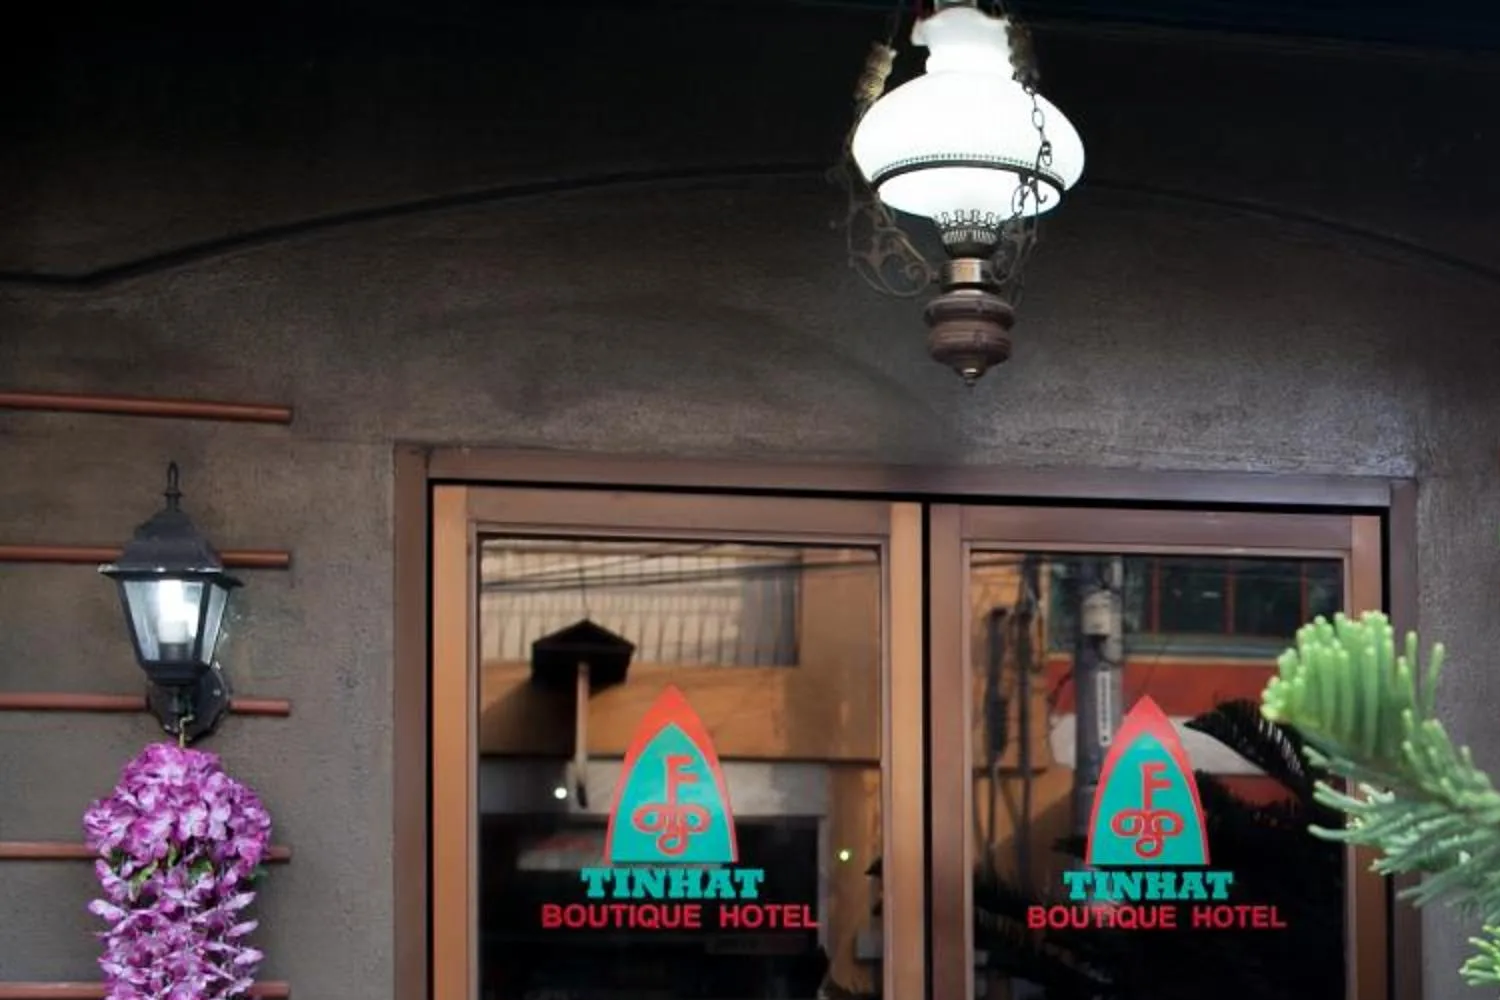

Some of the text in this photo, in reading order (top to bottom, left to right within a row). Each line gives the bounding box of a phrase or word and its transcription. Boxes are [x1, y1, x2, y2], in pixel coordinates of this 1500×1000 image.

[581, 867, 764, 898] TINHAT
[1063, 871, 1234, 900] TINHAT
[541, 903, 821, 929] BOUTIQUE HOTEL
[1026, 905, 1287, 929] BOUTIQUE HOTEL
